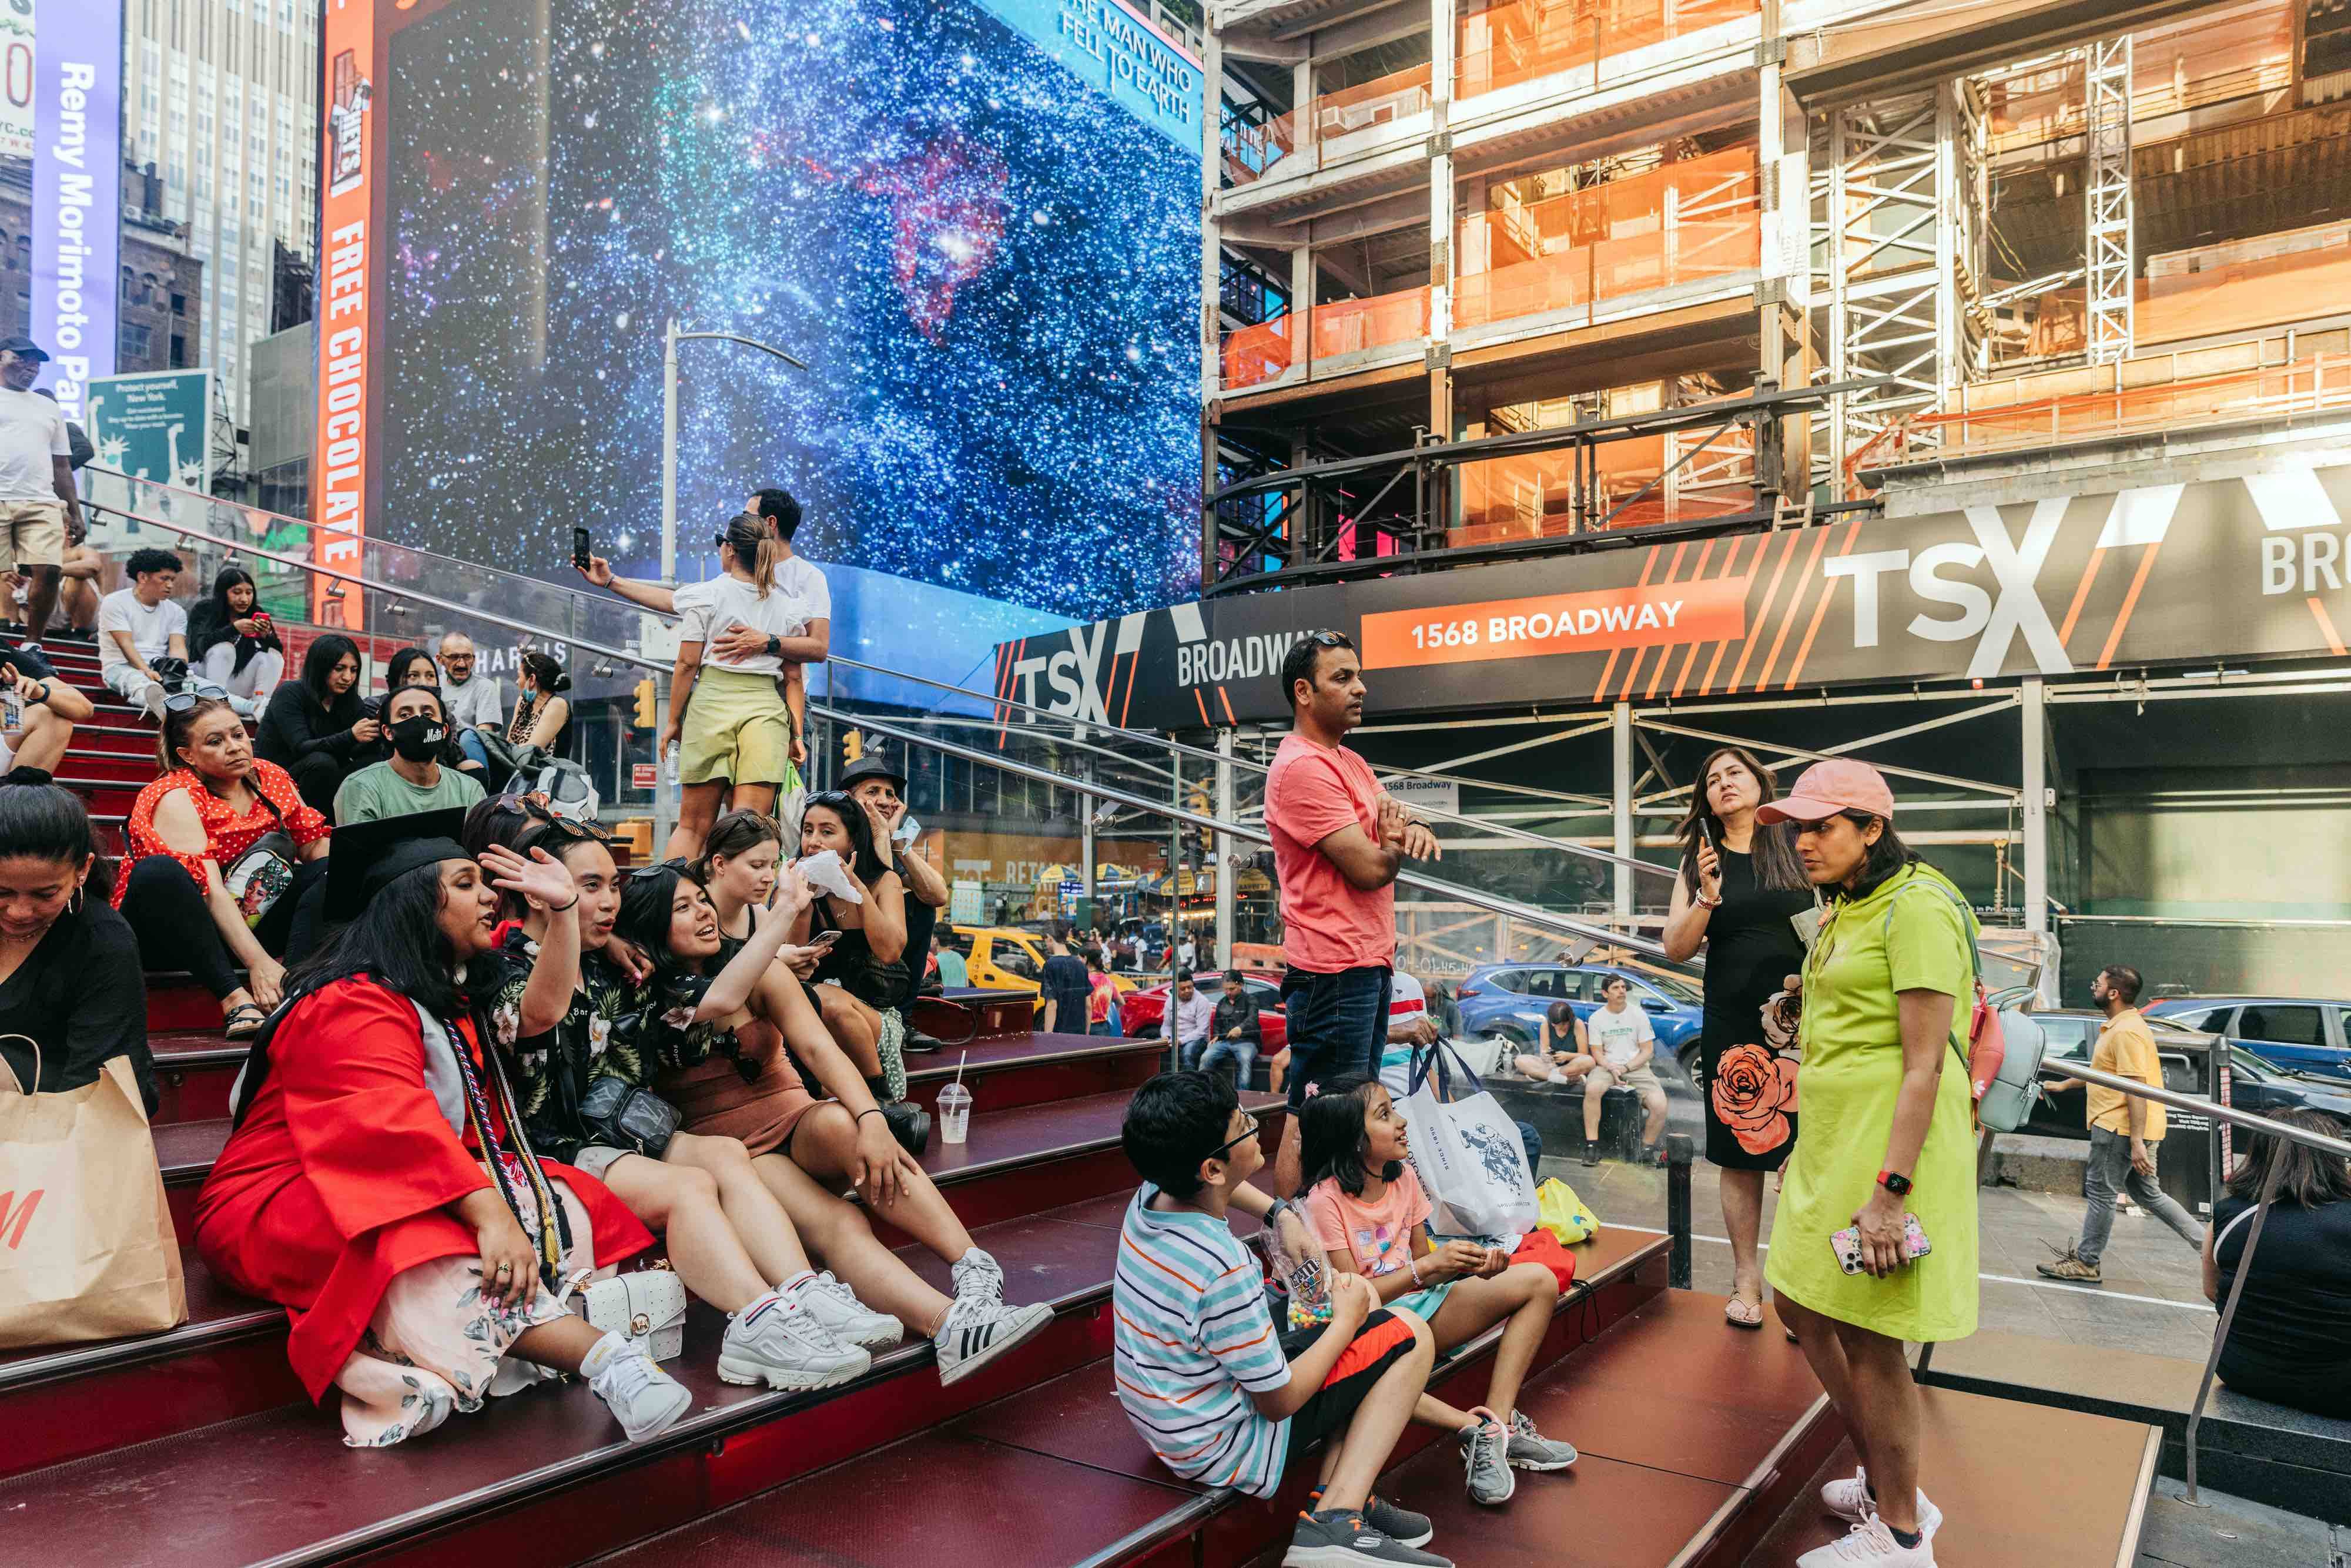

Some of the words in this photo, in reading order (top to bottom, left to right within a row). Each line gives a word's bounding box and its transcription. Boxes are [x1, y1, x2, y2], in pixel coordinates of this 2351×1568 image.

[1063, 11, 1105, 63] FELL
[1107, 42, 1133, 93] TO
[1137, 66, 1190, 123] EARTH
[1104, 8, 1147, 61] MAN
[1150, 43, 1192, 93] WHO
[52, 62, 95, 169] Remy
[56, 175, 92, 349] Morimoto
[330, 220, 364, 320] FREE
[324, 326, 363, 564] CHOCOLATE
[1824, 496, 2077, 679] TSX
[2261, 532, 2351, 596] BR
[475, 642, 567, 674] HARIS
[1177, 629, 1315, 687] BROADW
[1411, 619, 1479, 649] 1568
[1489, 600, 1684, 644] BROADWAY
[1014, 619, 1111, 741] TSX
[423, 728, 442, 743] Mets
[1384, 782, 1404, 791] 1568
[1406, 780, 1452, 790] Broadway
